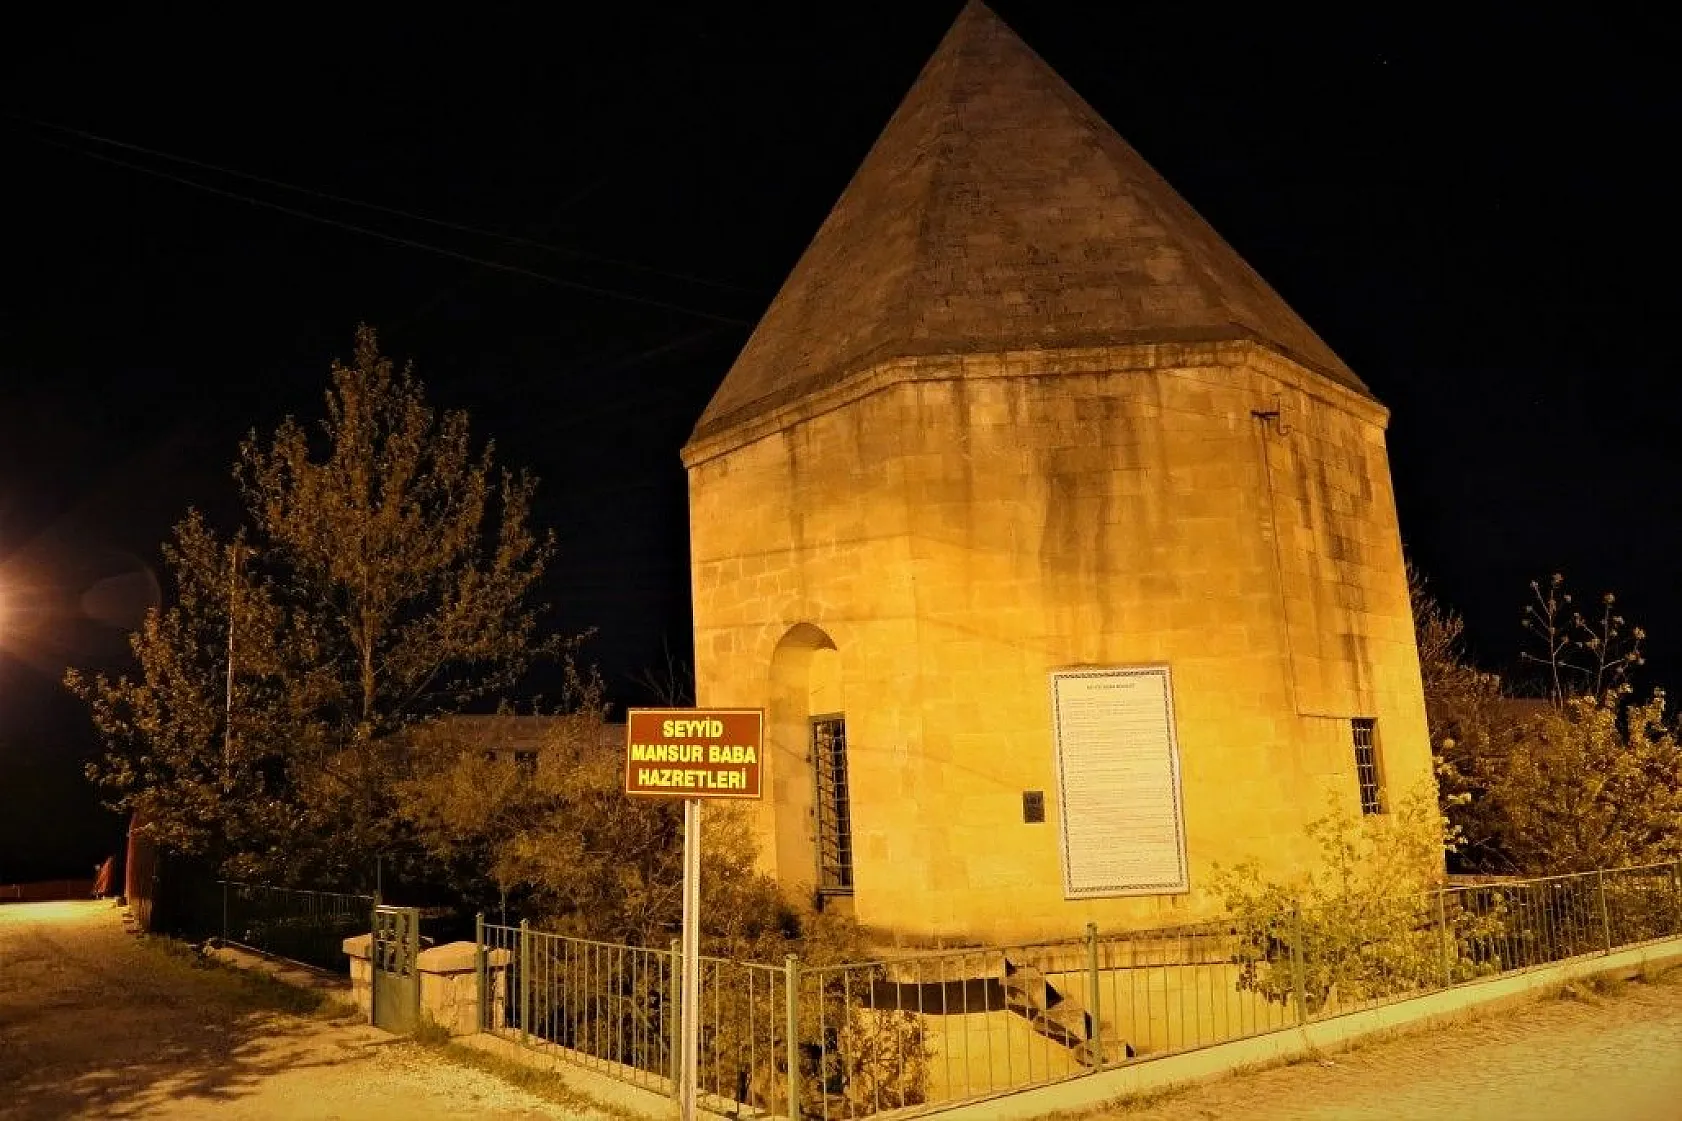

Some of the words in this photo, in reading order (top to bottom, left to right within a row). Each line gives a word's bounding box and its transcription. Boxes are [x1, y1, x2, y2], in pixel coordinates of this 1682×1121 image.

[663, 716, 723, 738] SEYYİD
[631, 744, 704, 763] MANSUR
[708, 745, 758, 764] BABA
[638, 767, 747, 789] HAZRETLERİ
